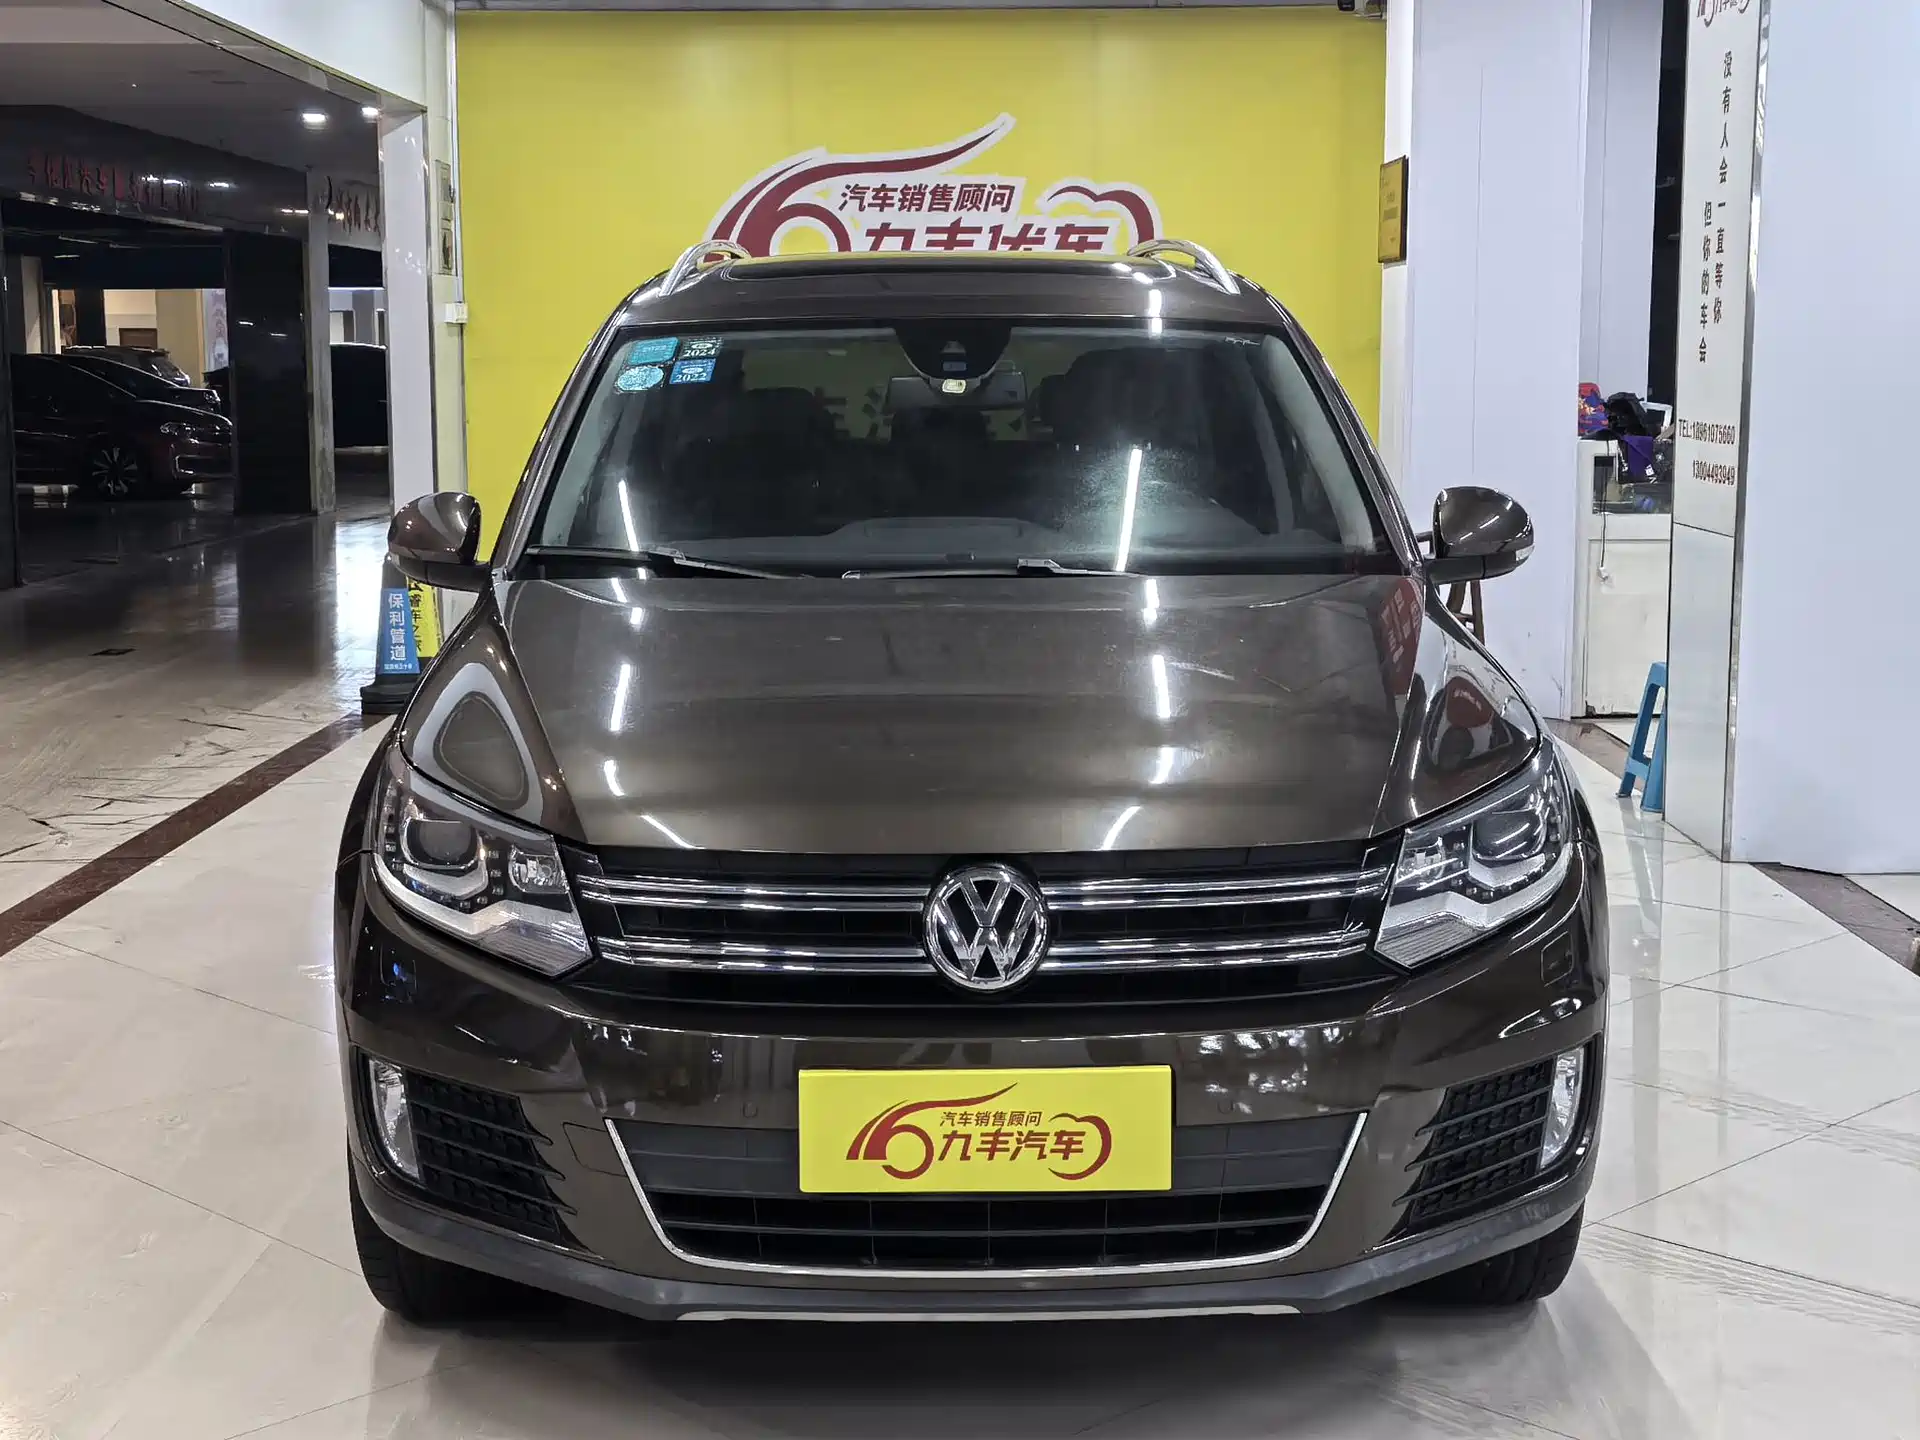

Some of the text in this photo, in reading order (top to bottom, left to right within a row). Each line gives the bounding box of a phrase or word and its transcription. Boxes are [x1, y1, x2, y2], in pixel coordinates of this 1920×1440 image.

[838, 183, 1015, 213] 汽车销售顾问
[1714, 50, 1732, 325] 没有人会一直等你
[1699, 201, 1712, 363] 但你的车会
[672, 373, 707, 383] 2022
[938, 1110, 1043, 1128] 汽车销售顾问
[937, 1127, 1087, 1161] 九丰汽车
